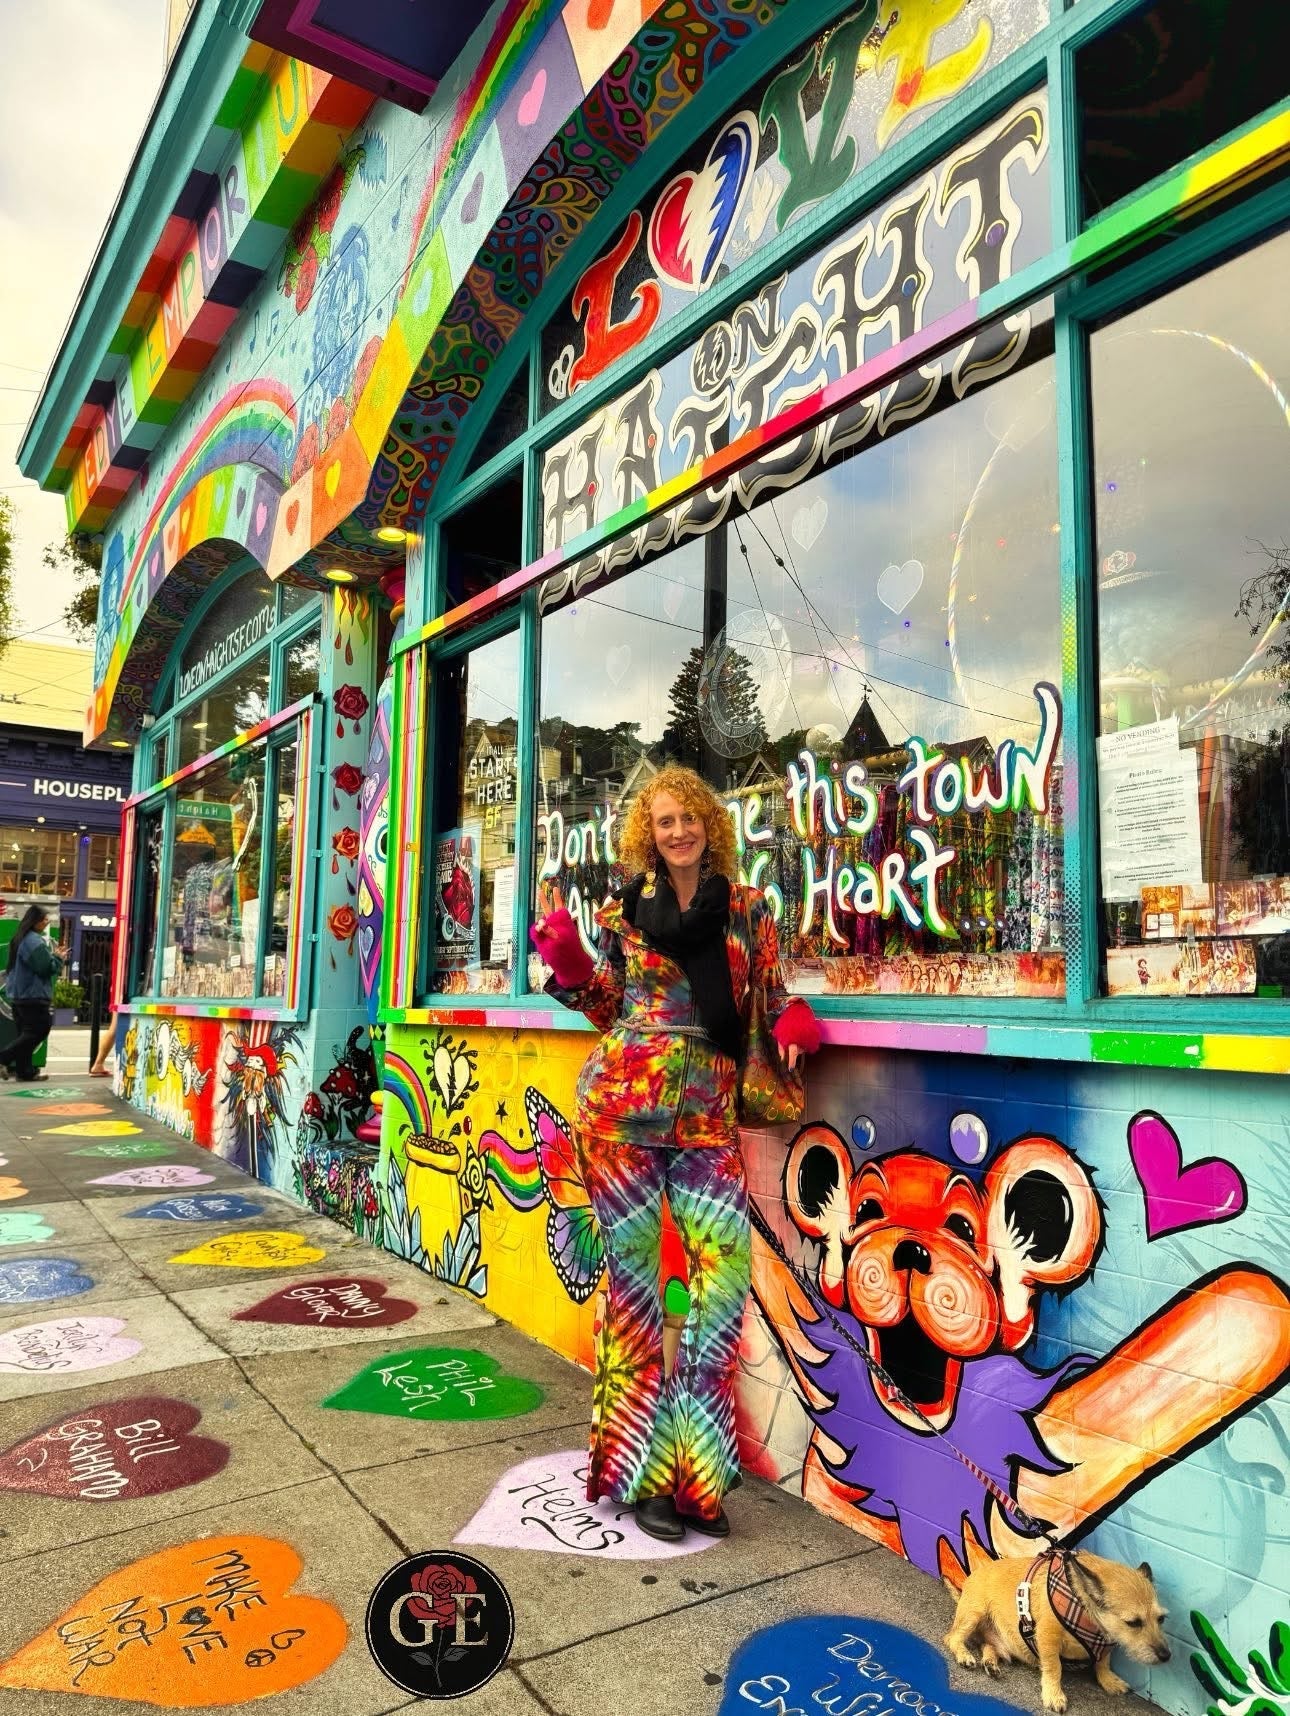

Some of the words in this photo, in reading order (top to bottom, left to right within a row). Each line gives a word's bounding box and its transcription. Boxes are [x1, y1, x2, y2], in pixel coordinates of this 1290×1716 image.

[538, 98, 1050, 617] HAIGHT
[692, 271, 788, 397] ON
[477, 775, 512, 806] HERE
[485, 805, 502, 829] SF
[537, 800, 617, 886] Don't
[786, 748, 878, 838] this
[508, 1473, 625, 1551] Helms
[56, 1614, 117, 1687] WAR
